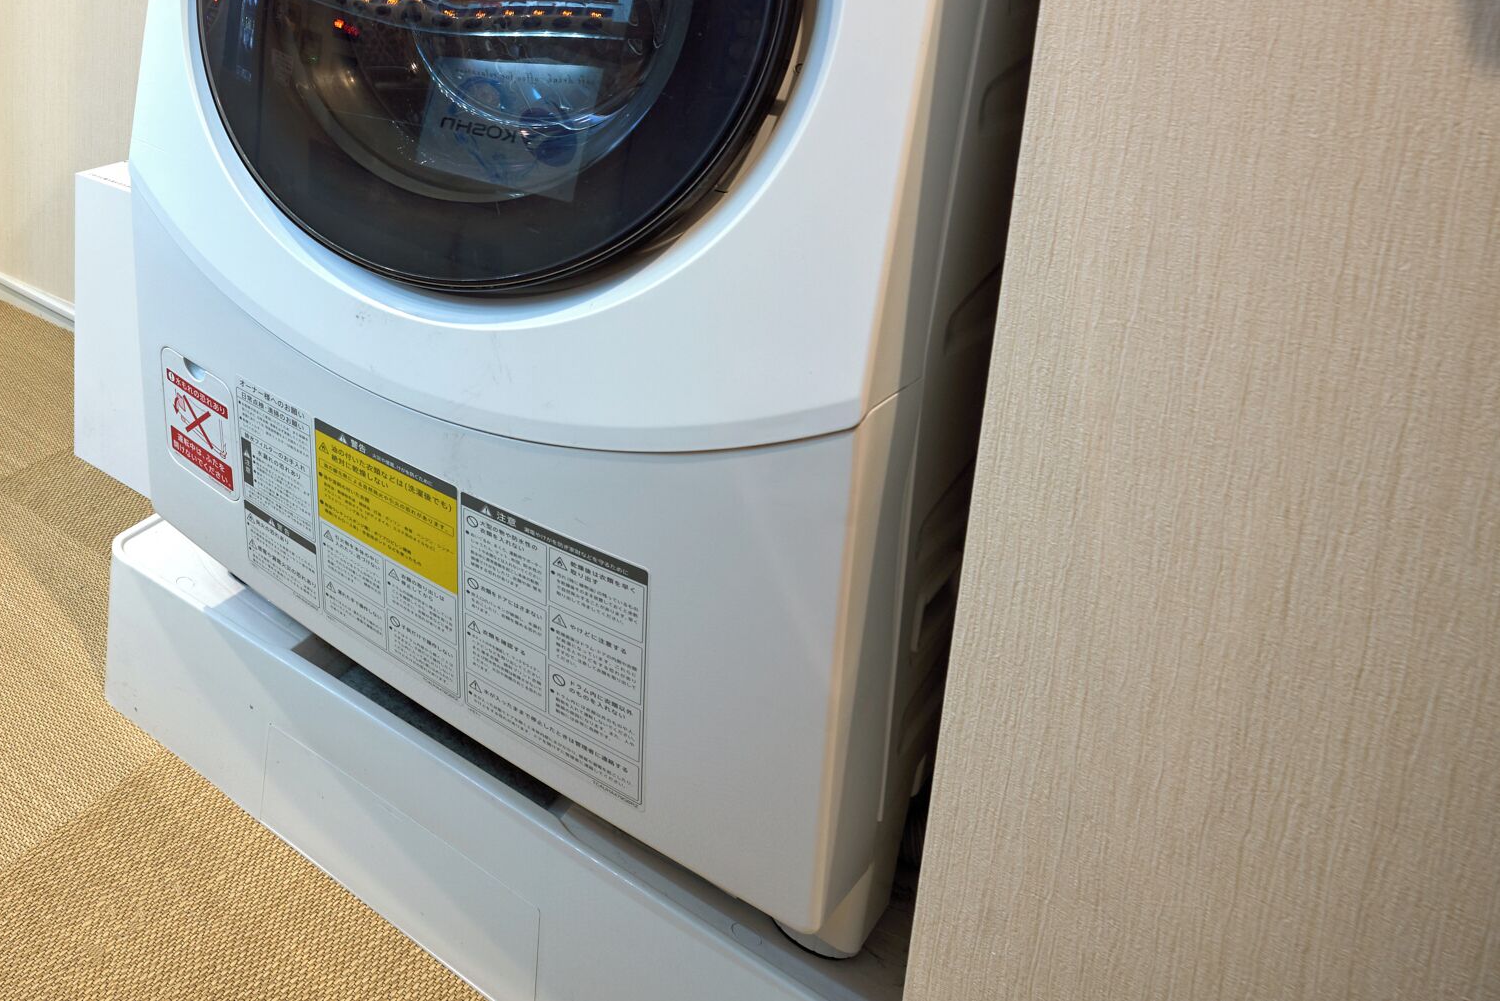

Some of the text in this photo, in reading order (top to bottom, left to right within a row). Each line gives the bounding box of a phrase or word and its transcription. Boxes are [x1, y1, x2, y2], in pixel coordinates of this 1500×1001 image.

[175, 377, 226, 415] 水もれの恐れあり
[240, 379, 305, 419] オーナー様へのお願い
[172, 439, 233, 487] 開けないでください。
[177, 433, 225, 473] 運転中は、ふたを
[350, 438, 367, 455] 警告
[331, 455, 390, 489] 絶対に乾燥しない
[496, 510, 517, 528] 注意
[480, 528, 525, 552] 衣類を入れない
[570, 560, 636, 594] 乾燥後は衣類を早く
[570, 568, 598, 586] 取り出す
[569, 623, 628, 655] やけどに注意する
[569, 687, 626, 720] のものを入れない
[570, 680, 634, 717] ドラム内に衣類以外
